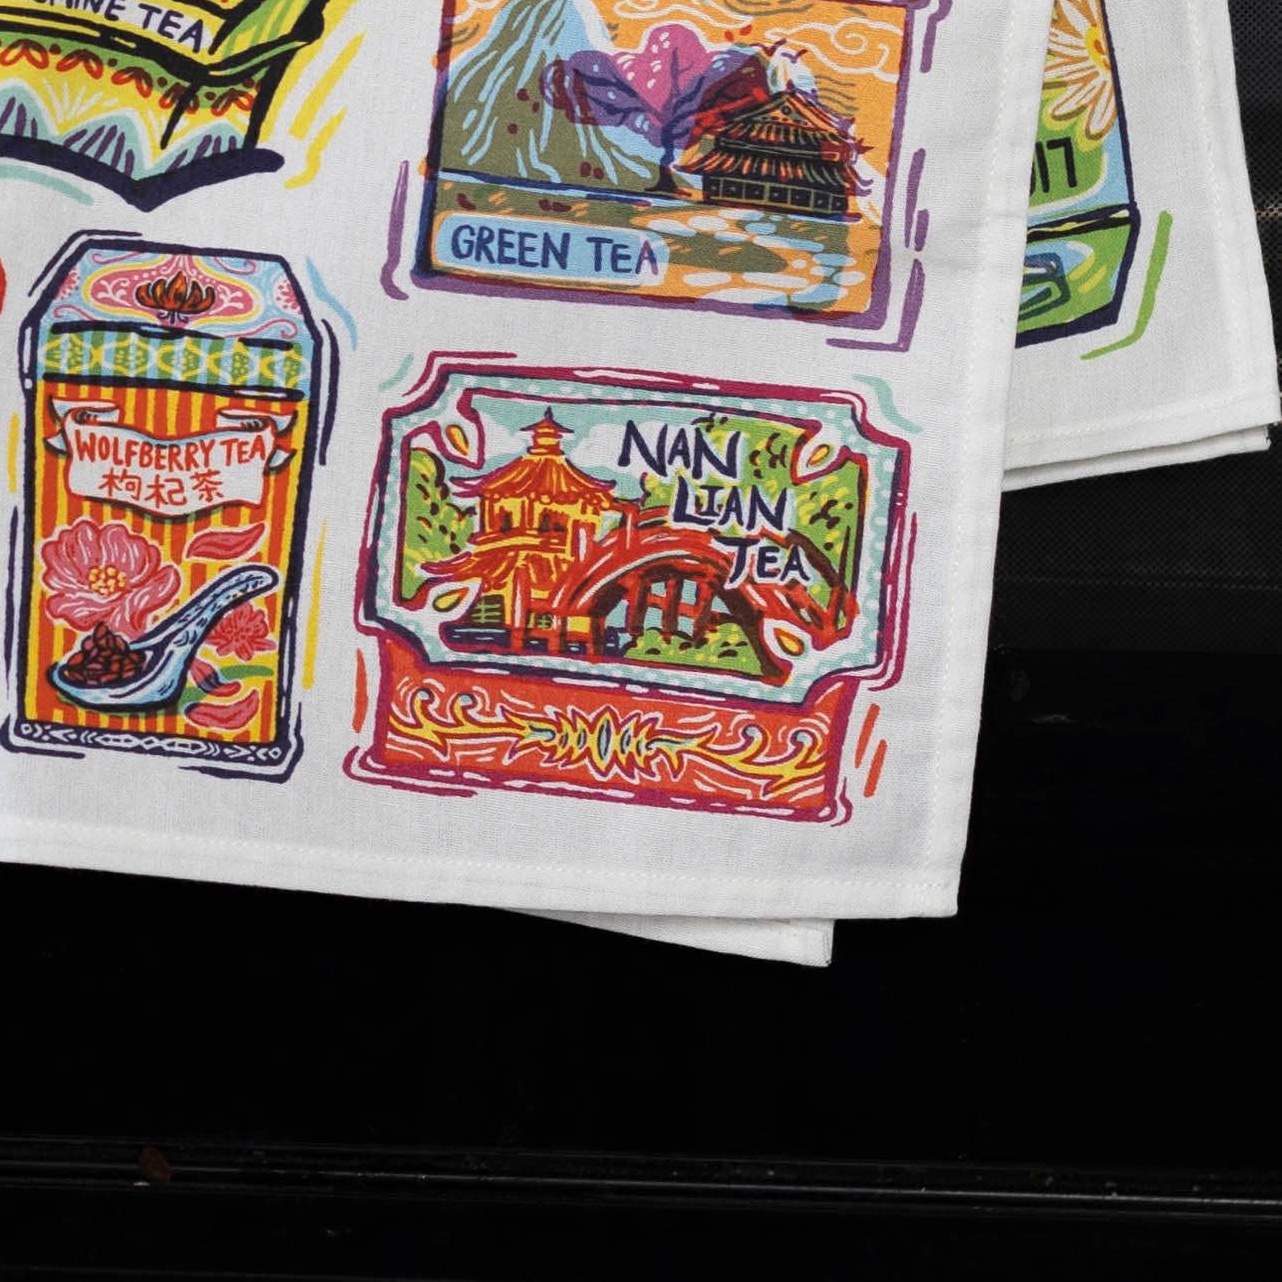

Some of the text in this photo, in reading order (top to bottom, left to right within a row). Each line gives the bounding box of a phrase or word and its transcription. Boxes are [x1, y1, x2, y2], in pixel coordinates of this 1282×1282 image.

[138, 2, 206, 54] TEA
[450, 224, 659, 276] GREEN TEA
[73, 429, 267, 473] WOLFBERRY TEA
[618, 419, 742, 480] NAN
[672, 475, 789, 532] LIAN
[711, 536, 811, 585] TEA
